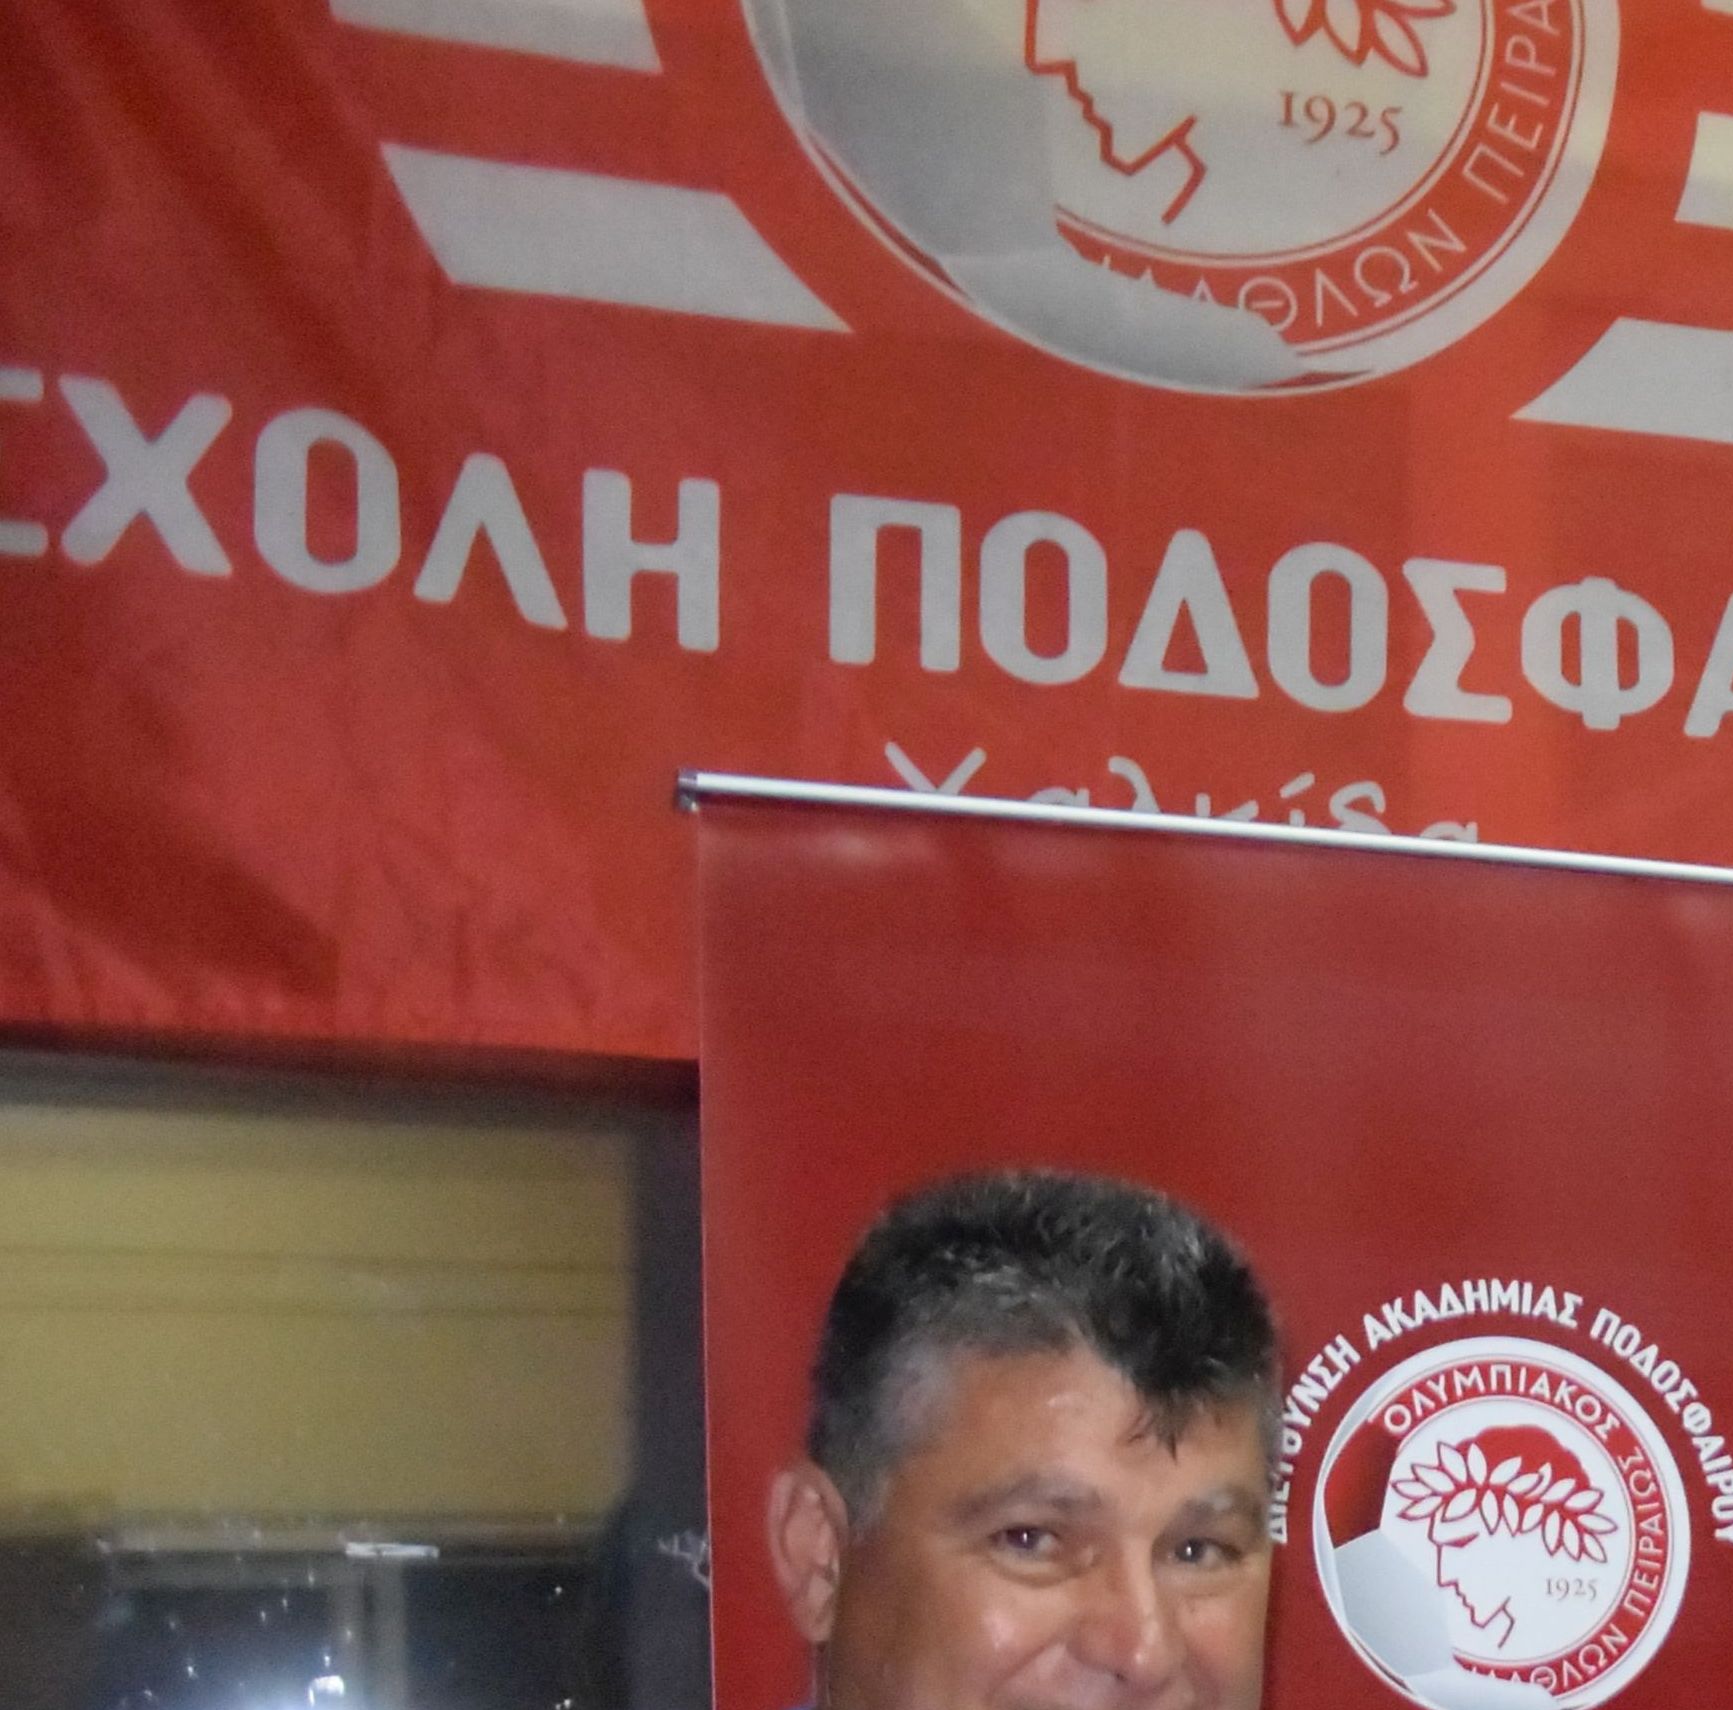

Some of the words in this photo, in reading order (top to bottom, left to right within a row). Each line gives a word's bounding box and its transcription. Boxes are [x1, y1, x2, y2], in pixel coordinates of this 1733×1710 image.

[1277, 91, 1402, 154] 1925
[1363, 1278, 1583, 1351] ΑΚΑΔΗΜΙΑΣ
[1384, 1363, 1621, 1441] ΟΛΥΜΠΙΑΚΟΣ
[1617, 1446, 1664, 1617] ΠΕΙΡΑΙΩΣ
[1545, 1576, 1599, 1602] 1925
